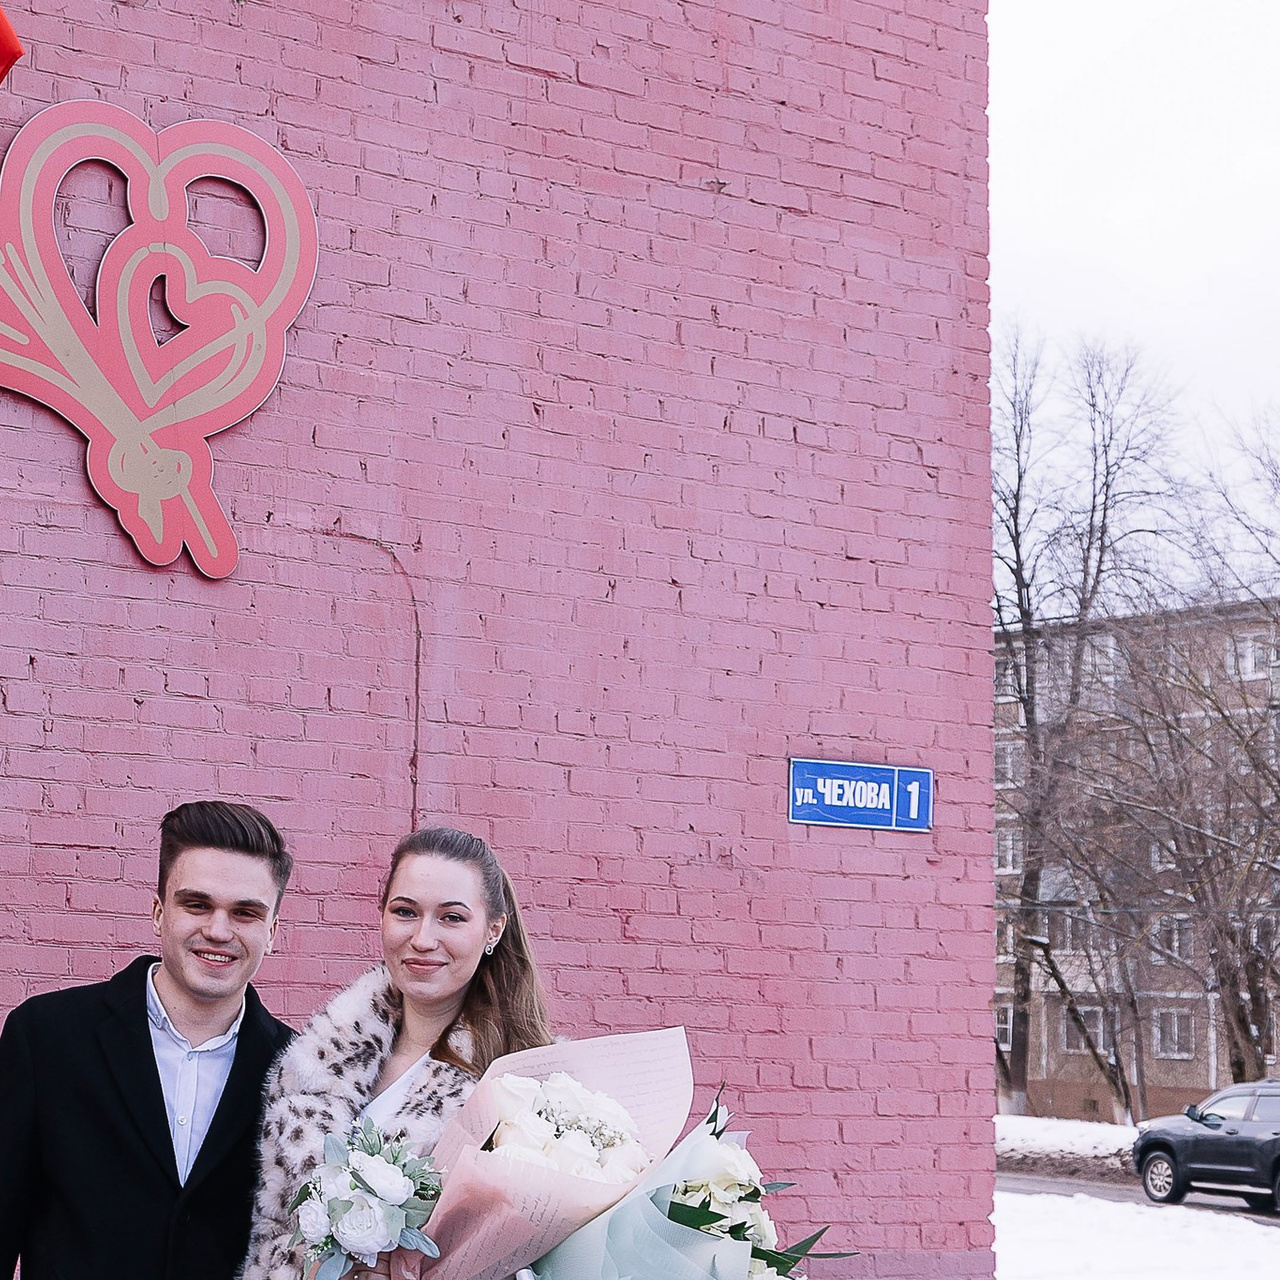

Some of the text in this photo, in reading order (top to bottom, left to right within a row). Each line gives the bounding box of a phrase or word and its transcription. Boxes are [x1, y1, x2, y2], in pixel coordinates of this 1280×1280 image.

[795, 778, 920, 819] ул. ЧЕХОВА 1
